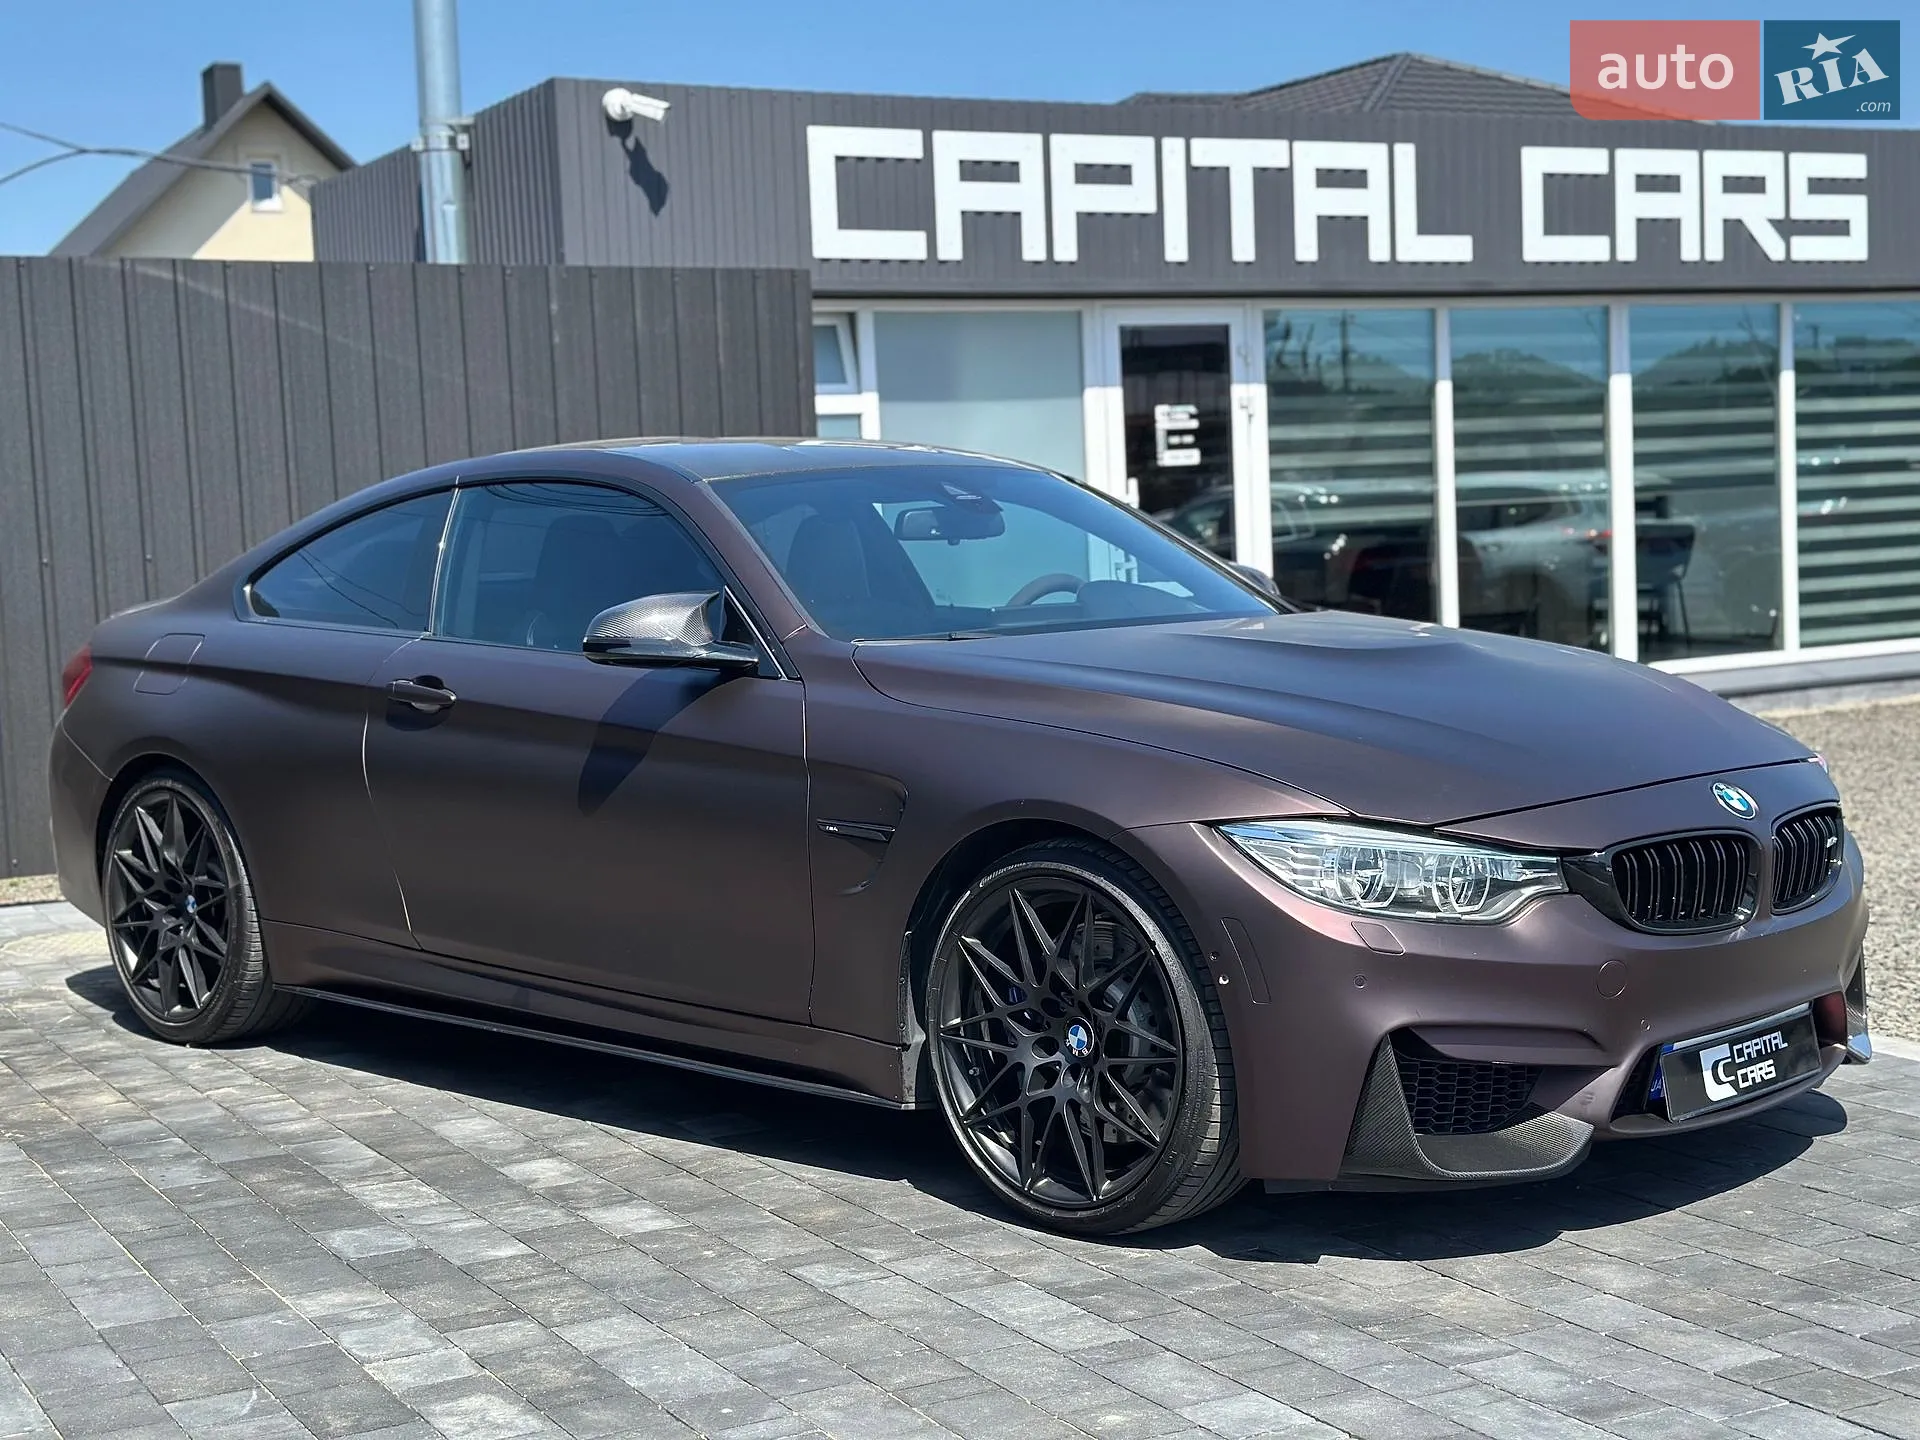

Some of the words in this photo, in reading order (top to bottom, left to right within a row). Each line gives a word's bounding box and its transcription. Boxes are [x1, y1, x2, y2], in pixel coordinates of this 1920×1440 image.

[806, 125, 1473, 263] CAPITAL
[1520, 145, 1869, 263] CARS
[1732, 1030, 1789, 1064] CAPITAL
[1736, 1059, 1777, 1089] CARS
